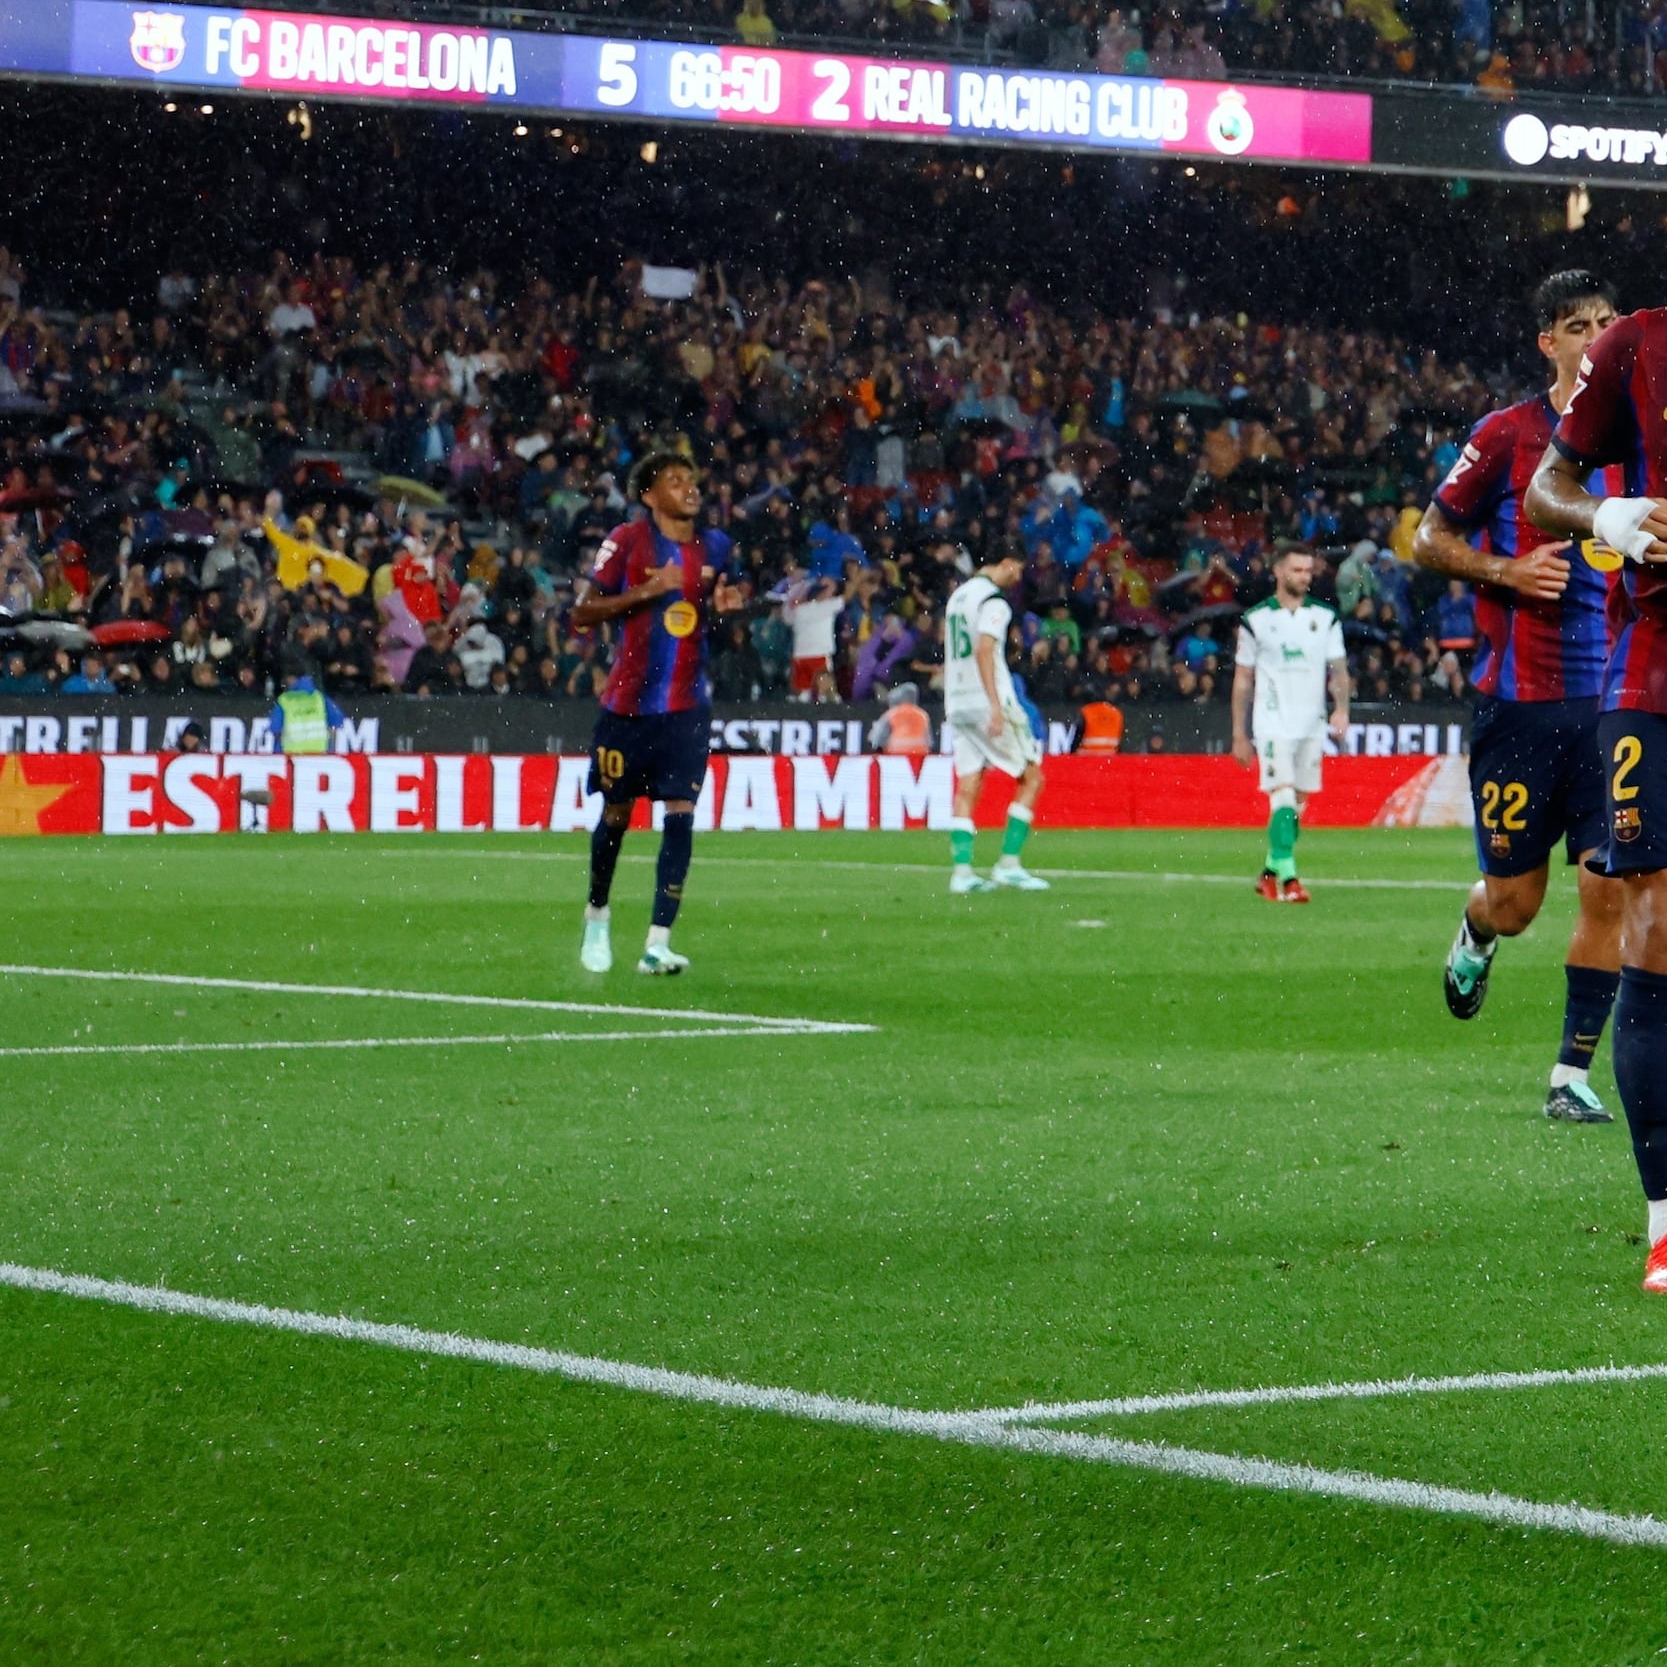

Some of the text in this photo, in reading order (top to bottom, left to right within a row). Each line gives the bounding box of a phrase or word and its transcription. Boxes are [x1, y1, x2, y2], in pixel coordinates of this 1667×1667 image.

[205, 16, 517, 96] FC BARCELONA
[597, 42, 638, 107] 5
[812, 58, 851, 122] 2
[864, 65, 1188, 142] REAL RACING CLUB
[102, 755, 602, 835] ESTRELLA
[597, 745, 625, 780] 10
[1612, 735, 1643, 802] 2
[1480, 781, 1529, 831] 22
